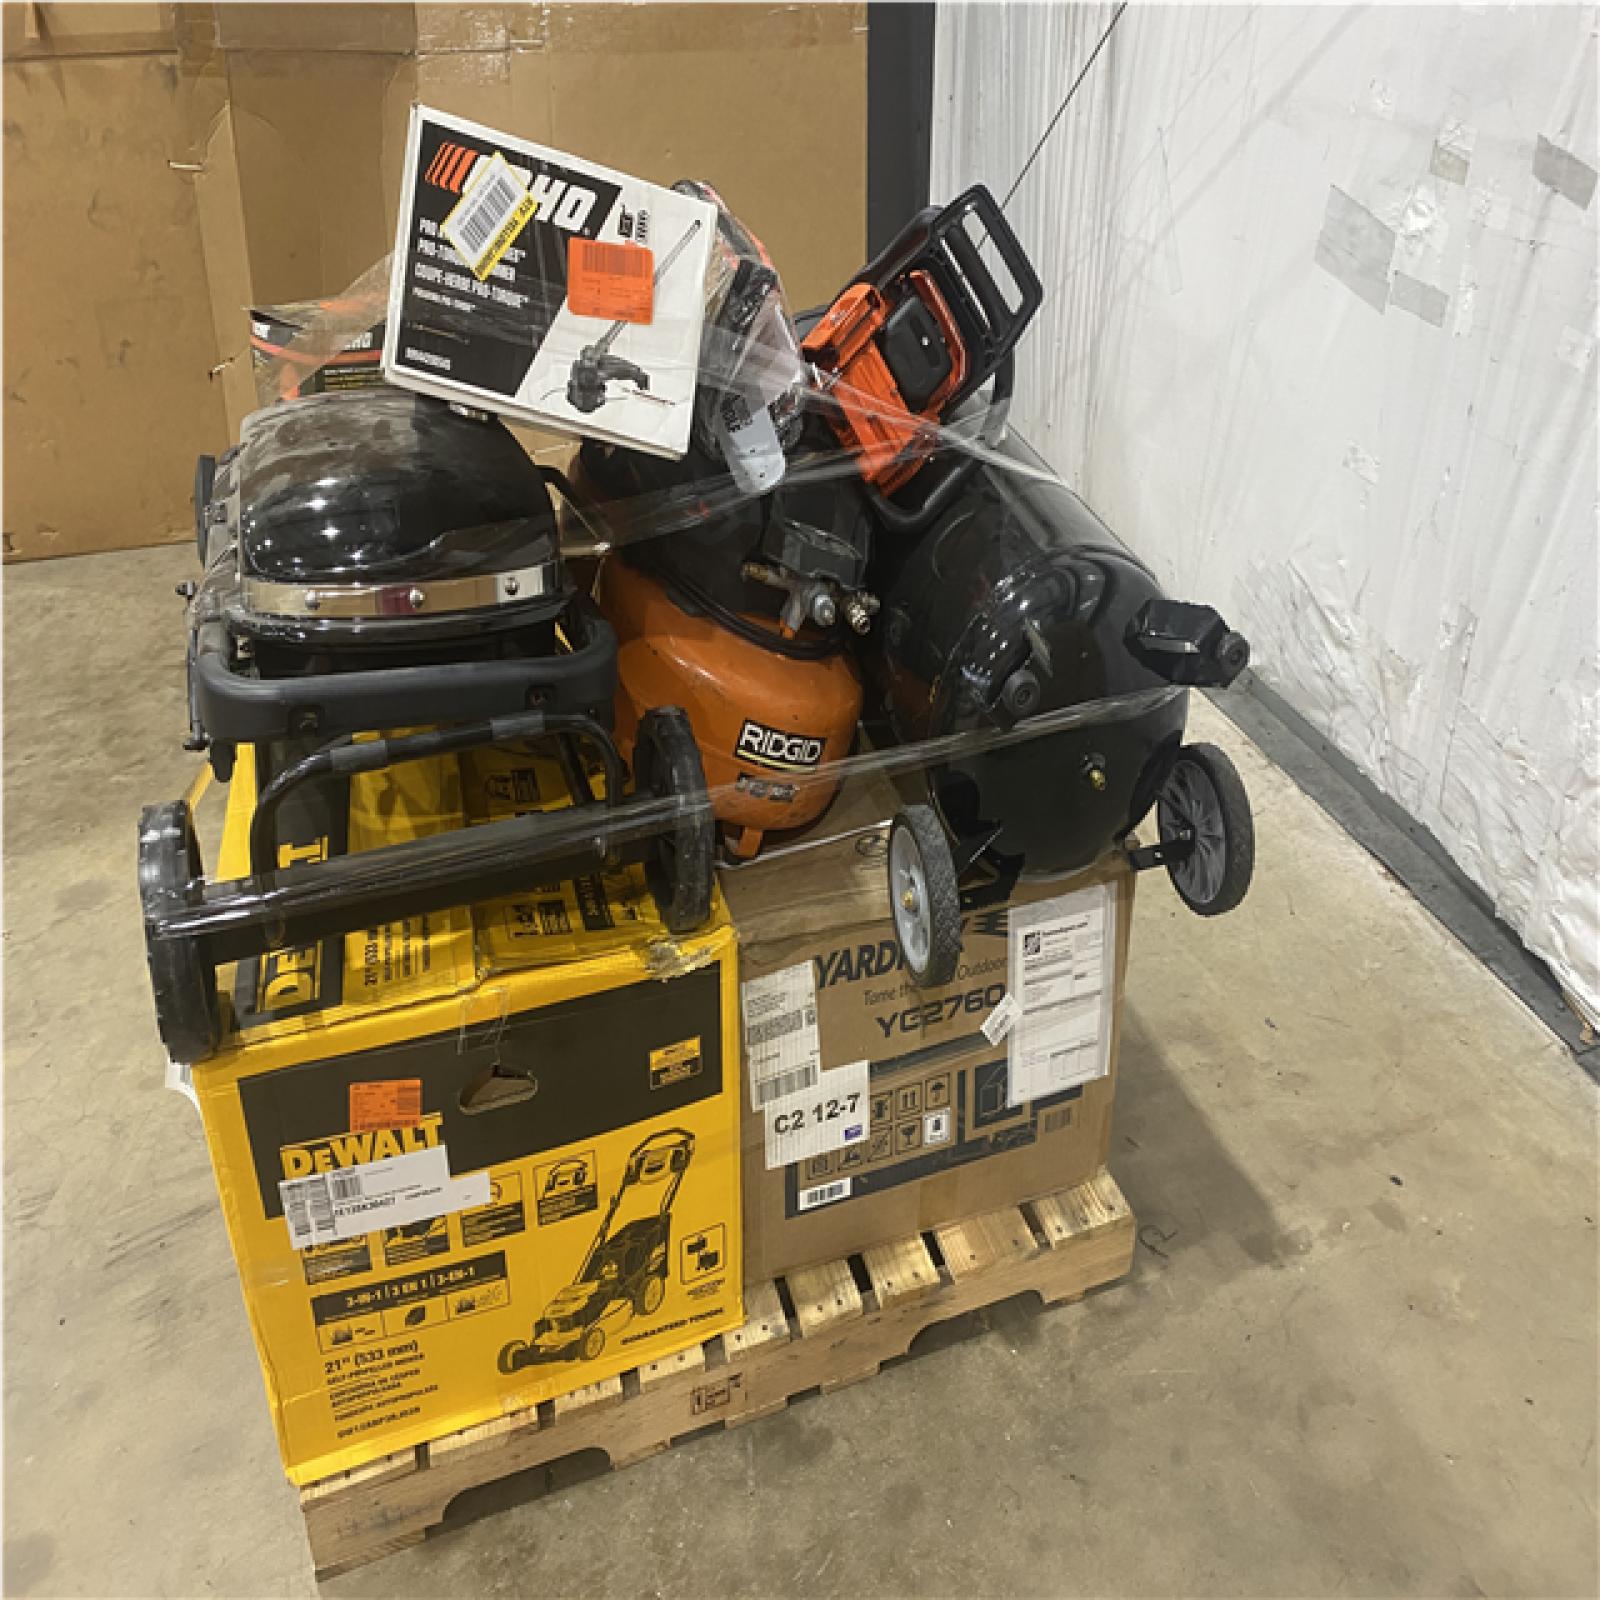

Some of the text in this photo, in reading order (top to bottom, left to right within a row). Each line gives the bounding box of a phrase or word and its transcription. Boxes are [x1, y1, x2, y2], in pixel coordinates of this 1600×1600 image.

[739, 722, 822, 762] RIDGID
[813, 939, 903, 989] YARD
[957, 956, 1008, 981] Outdoor
[773, 1092, 862, 1136] C2 12-7
